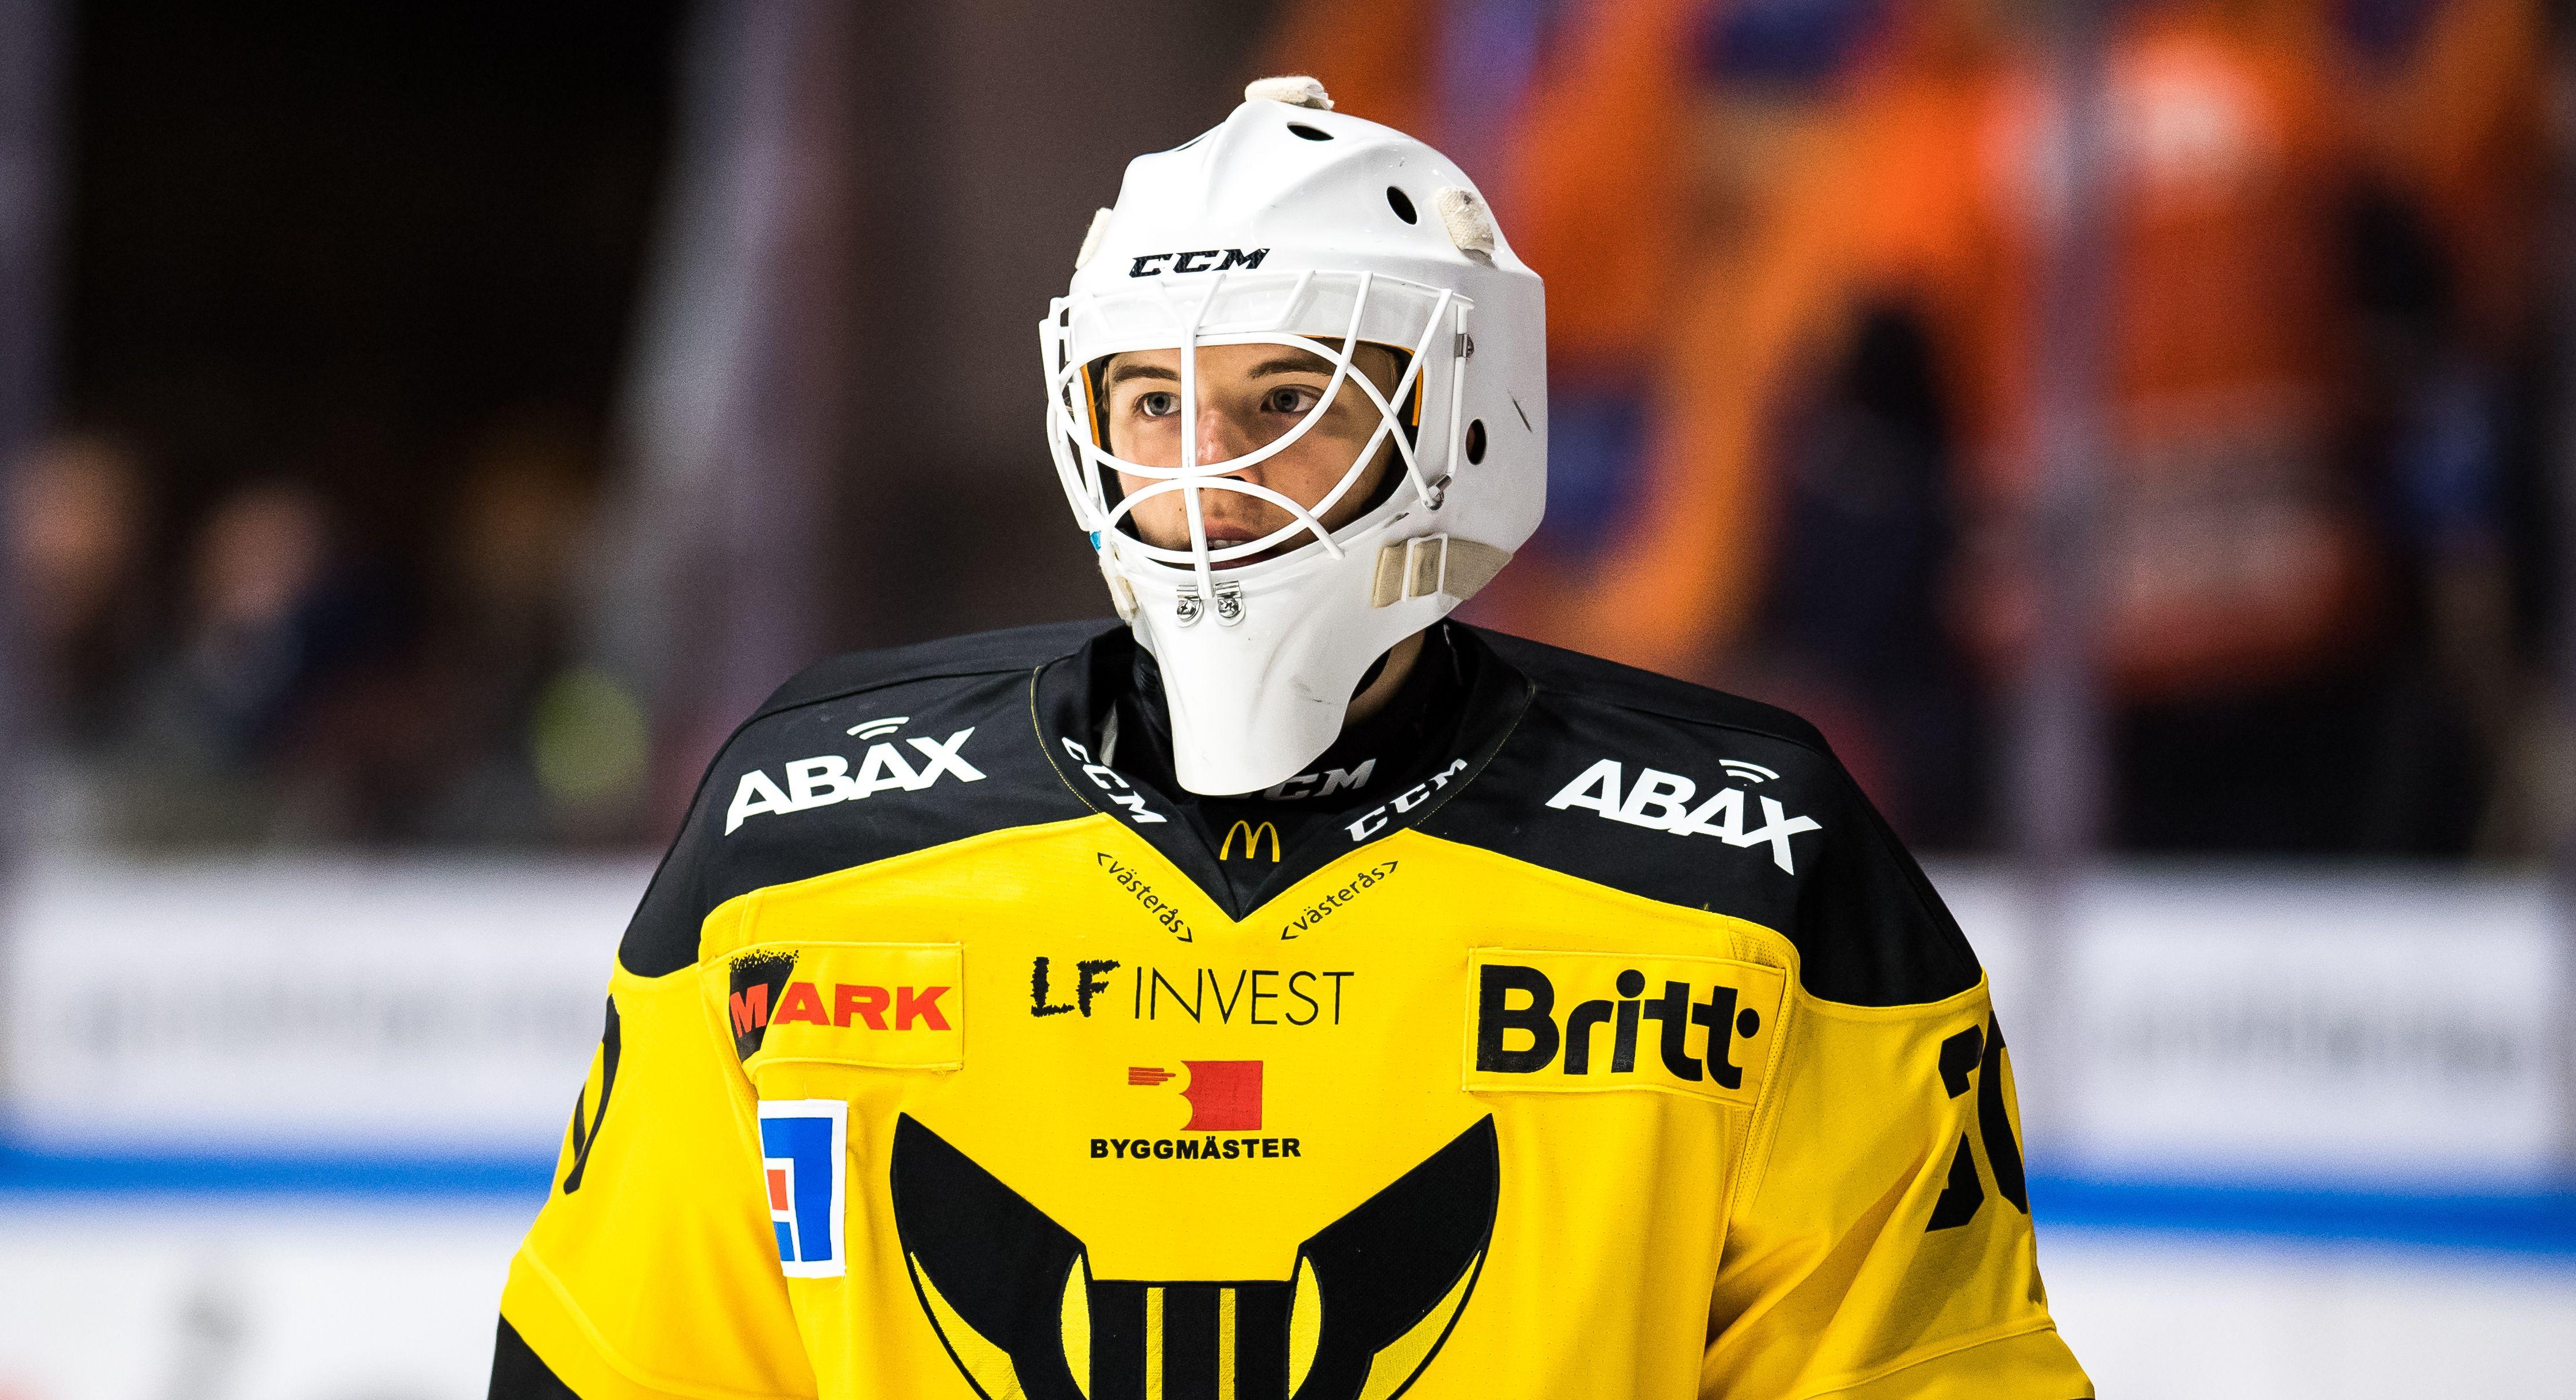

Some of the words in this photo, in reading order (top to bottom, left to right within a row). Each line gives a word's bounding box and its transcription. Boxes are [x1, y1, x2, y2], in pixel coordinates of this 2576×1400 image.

[1129, 248, 1270, 278] CCM
[725, 726, 987, 836] ABAX
[1061, 737, 1167, 823] CCM
[1229, 758, 1377, 800] CM
[1344, 758, 1468, 842] CCM
[1544, 759, 1822, 876] ABAX
[729, 981, 952, 1039] MARK
[1030, 957, 1121, 1018] LF
[1135, 967, 1354, 1026] INVEST
[1090, 1135, 1301, 1159] BYGGMÄSTER
